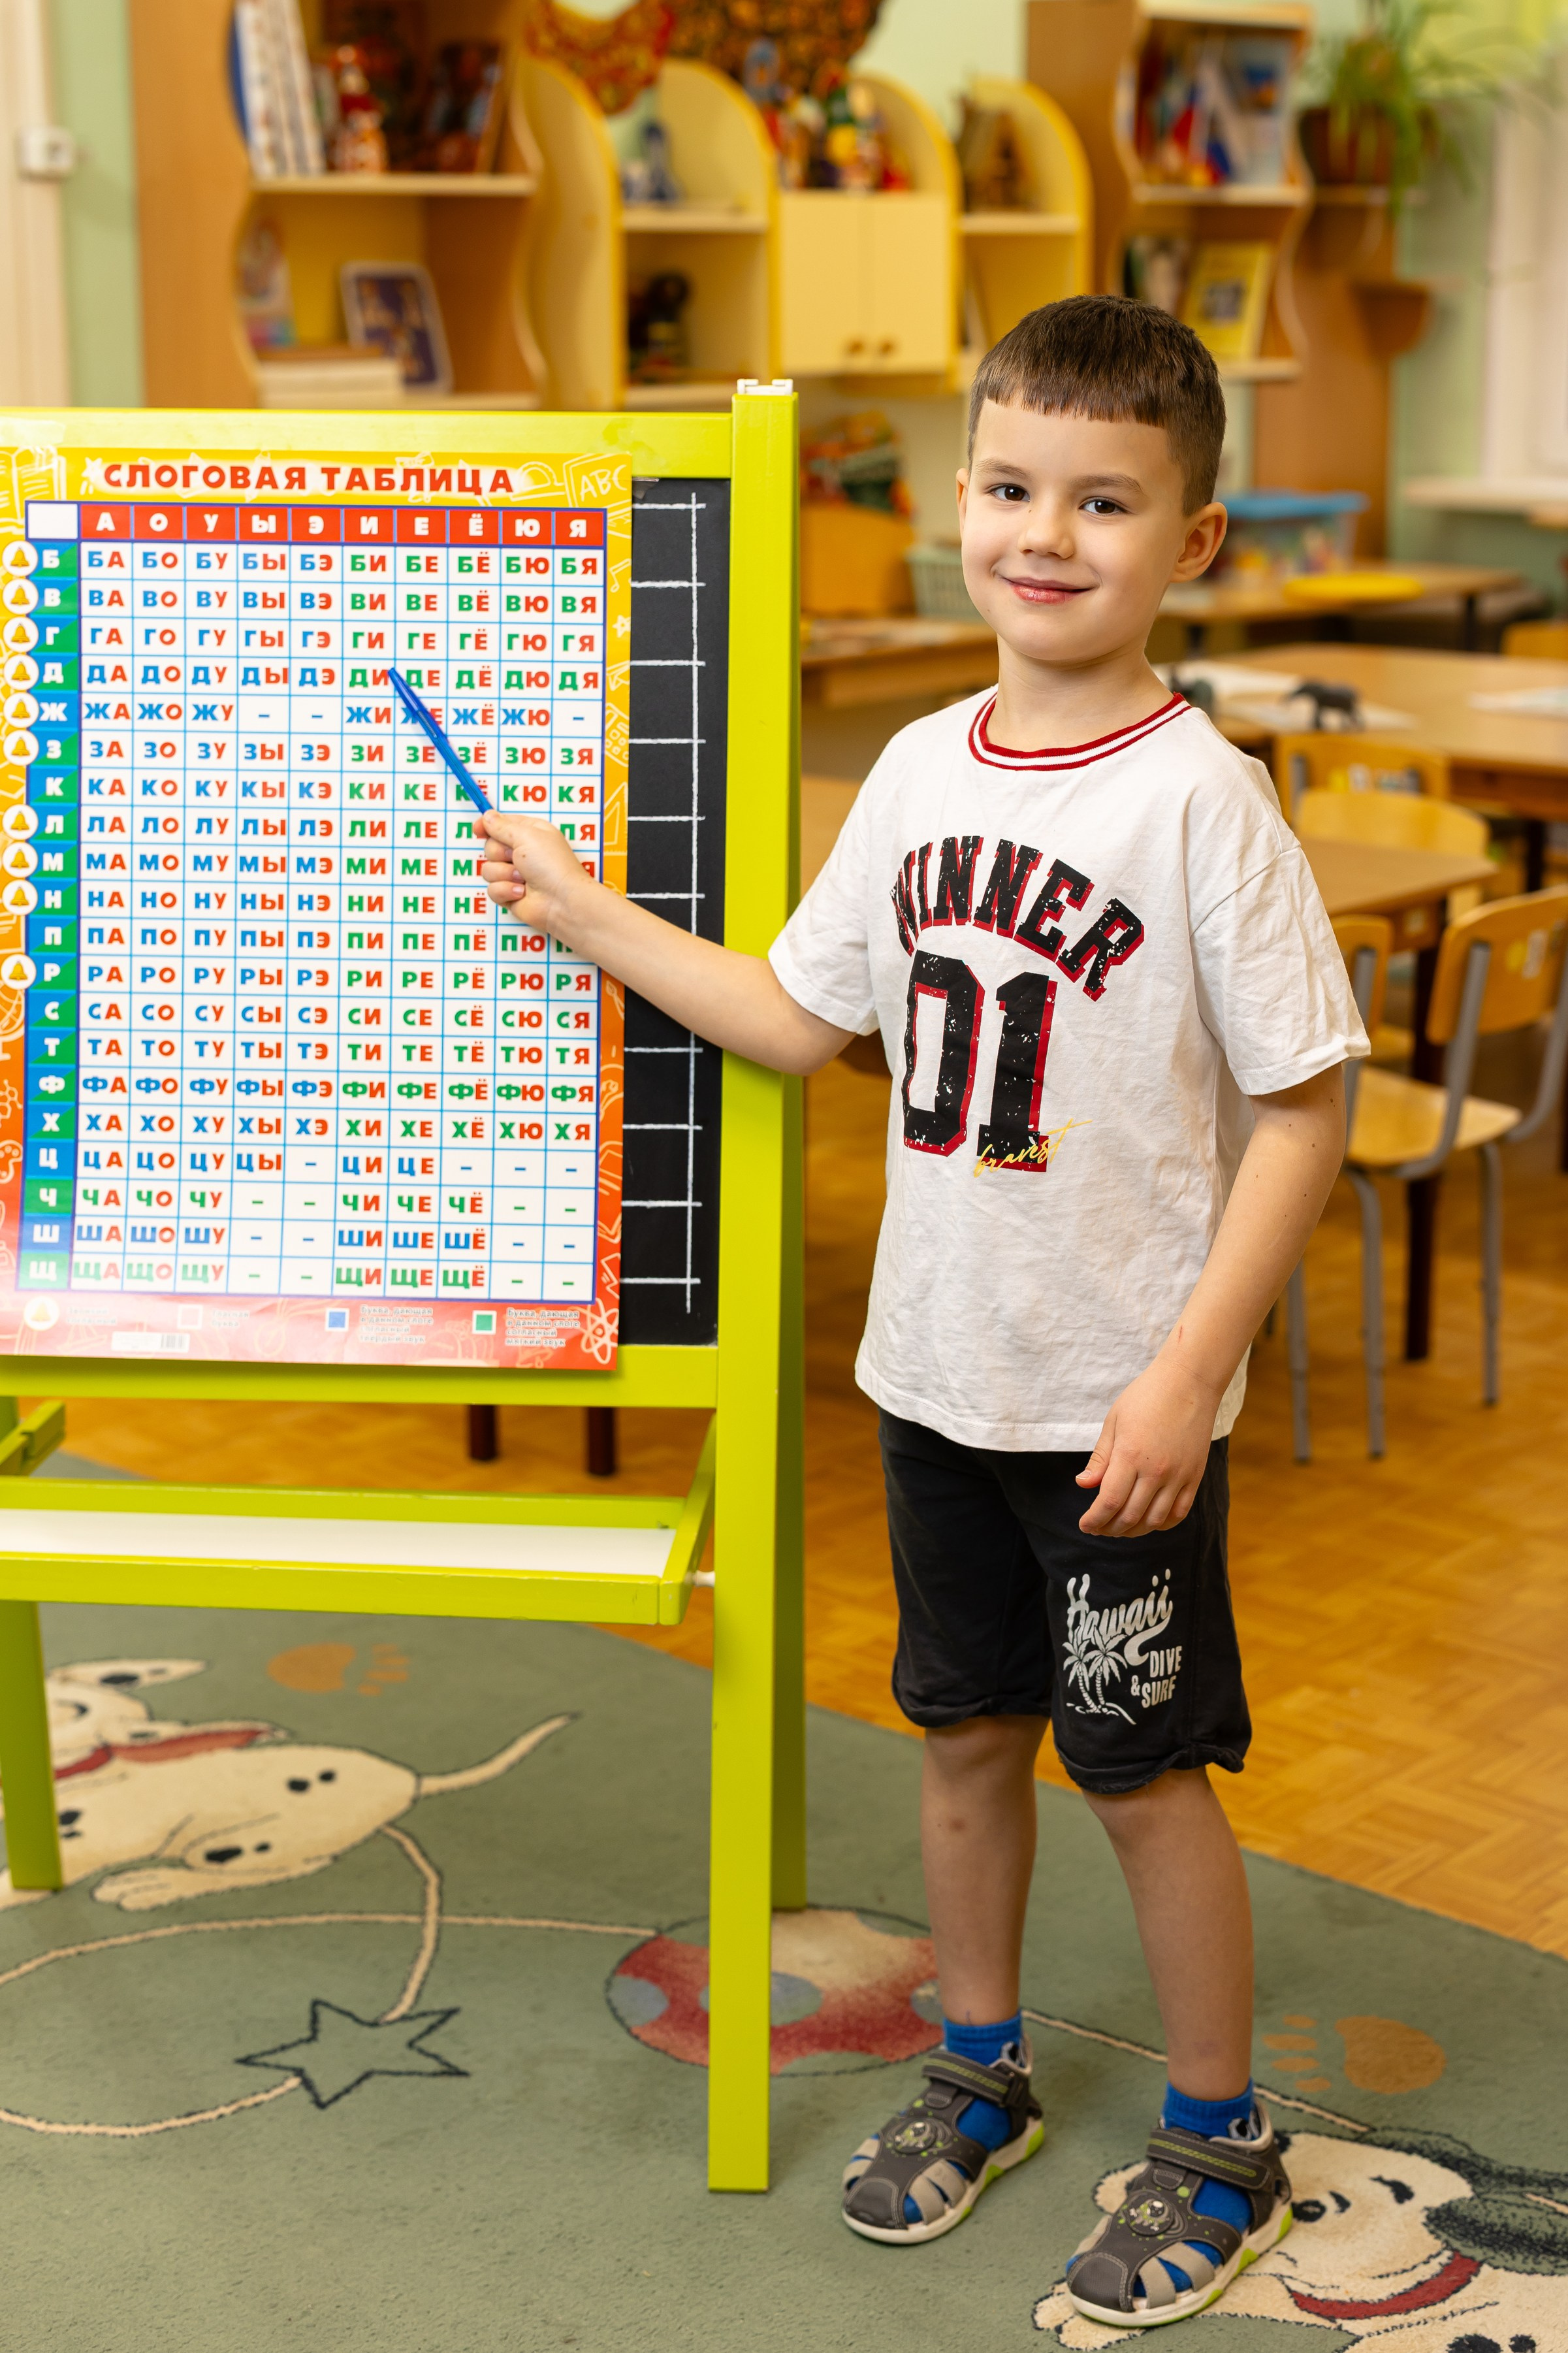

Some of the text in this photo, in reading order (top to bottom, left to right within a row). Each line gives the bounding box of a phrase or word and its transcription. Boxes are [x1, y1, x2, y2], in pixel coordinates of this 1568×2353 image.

[104, 464, 513, 496] СЛОГОВАЯ ТАБЛИЦА
[97, 513, 586, 537] А О У Ы Э И Е Ё Ю Я
[42, 550, 598, 575] Б БА БО БУ БЫ БЭ БИ БЕ БЁ БЮ БЯ
[44, 589, 61, 607] В
[46, 627, 594, 652] Г ГА ГО ГУ ГЫ ГЭ ГИ ГЕ ГЁ ГЮ ГЯ
[43, 663, 599, 690] Д ДА ДО ДУ ДЫ ДЭ ДИ ДЕ ДЁ ДЮ ДЯ
[40, 703, 67, 721] Ж
[85, 703, 131, 720] ЖА
[138, 704, 183, 721] ЖО
[193, 704, 234, 721] ЖУ
[347, 707, 391, 724] ЖИ
[453, 704, 494, 726] ЖЁ
[502, 709, 550, 726] ЖЮ
[46, 740, 61, 758] З
[46, 777, 63, 796] К
[88, 779, 125, 796] КА
[142, 779, 178, 796] КО
[196, 780, 227, 797] КУ
[242, 781, 285, 798] КЫ
[299, 782, 332, 800] КЭ
[349, 783, 385, 800] КИ
[404, 784, 436, 801] КЕ
[504, 785, 547, 803] КЮ
[558, 786, 595, 803] КЯ
[45, 815, 63, 834] Л
[43, 852, 63, 871] М
[44, 890, 62, 909] Н
[88, 891, 125, 908] НА
[141, 892, 177, 909] НО
[195, 892, 227, 909] НУ
[240, 893, 284, 911] НЫ
[298, 894, 331, 912] НЭ
[348, 895, 384, 913] НИ
[403, 896, 435, 914] НЕ
[455, 892, 487, 914] НЁ
[889, 836, 1144, 1001] WINNER
[44, 927, 62, 945] П
[44, 964, 592, 992] Р РА РО РУ РЫ РЭ РИ РЕ РЁ РЮ РЯ
[44, 1001, 59, 1020] С
[44, 1038, 590, 1065] Т ТА ТО ТУ ТЫ ТЭ ТИ ТЕ ТЁ ТЮ ТЯ
[903, 949, 1057, 1173] 01
[39, 1075, 594, 1103] Ф ФА ФО ФУ ФЫ ФЭ ФИ ФЕ ФЁ ФЮ ФЯ
[42, 1113, 59, 1131] Х
[39, 1148, 434, 1176] Ц ЦА ЦО ЦУ ЦЫ ЦИ ЦЕ
[39, 1188, 57, 1207] Ч
[33, 1225, 486, 1250] Ш ША ШО ШУ ШИ ШЕ ШЁ
[29, 1261, 485, 1290] Щ ЩА ЩО ЩУ ЩИ ЩЕ ЩЁ
[1067, 1568, 1173, 1666] Hawaii
[1149, 1646, 1182, 1678] DIVE
[1130, 1675, 1177, 1708] & SURF
